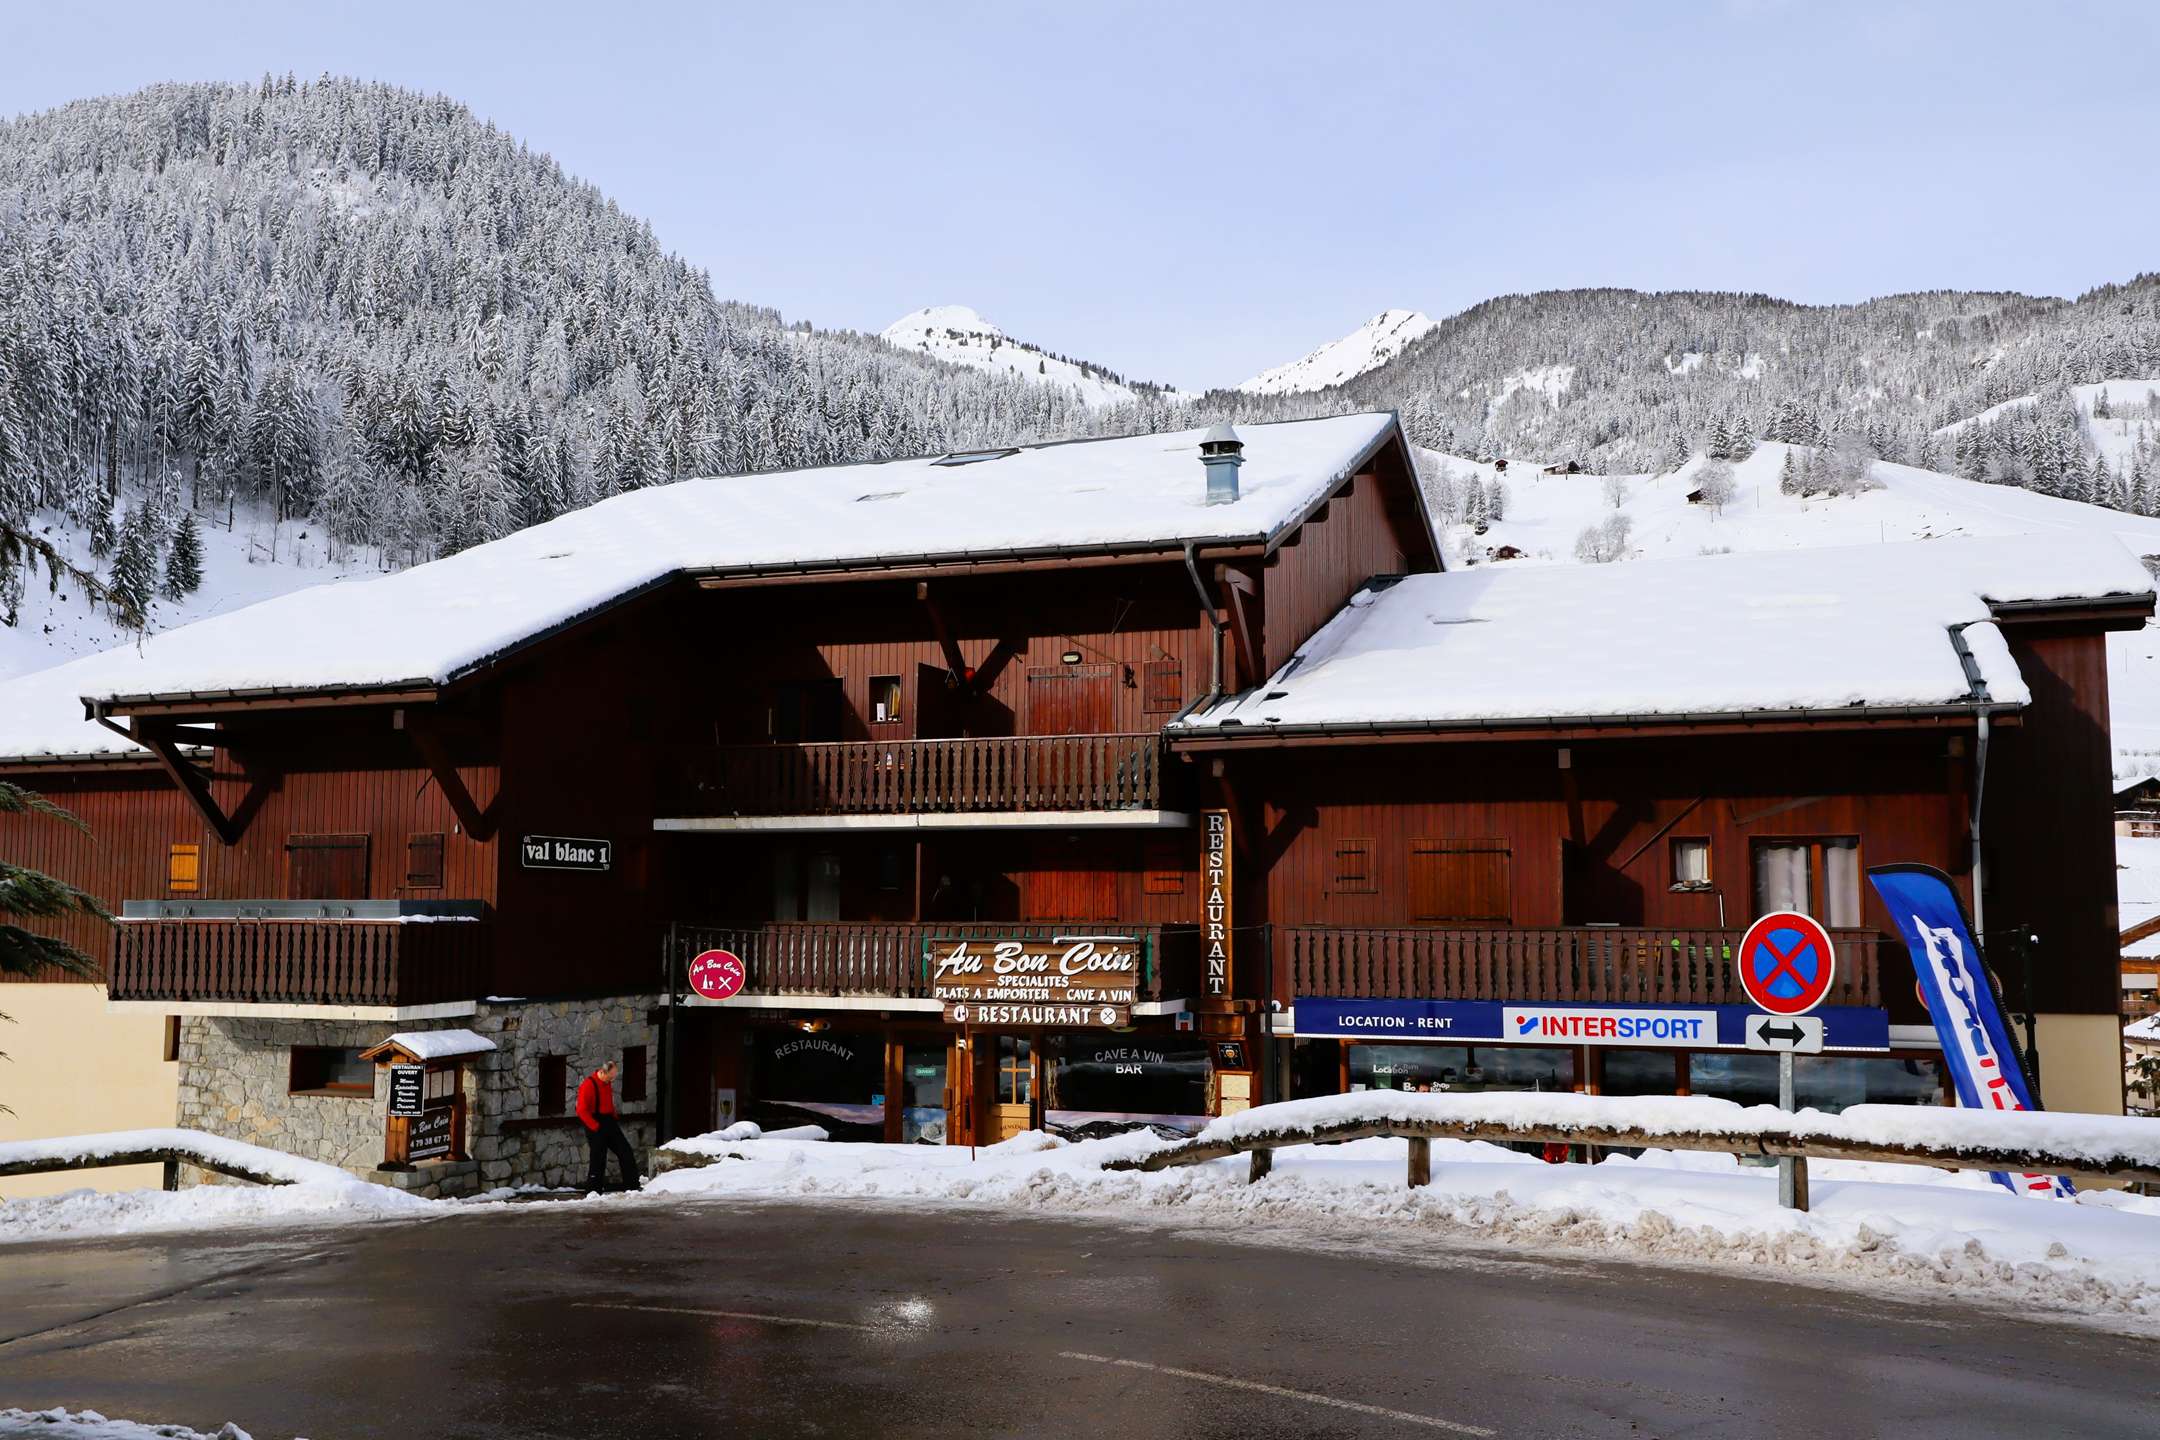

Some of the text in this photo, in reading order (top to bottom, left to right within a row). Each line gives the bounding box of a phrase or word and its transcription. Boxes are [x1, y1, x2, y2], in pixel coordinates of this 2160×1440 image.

[526, 841, 608, 863] val blanc 1
[1208, 815, 1226, 994] RESTAURANT
[693, 959, 741, 977] Au Bon Coin
[934, 942, 1133, 979] Au Bon Coin
[997, 975, 1069, 988] SPECIALITES
[935, 987, 969, 999] PLATS
[974, 989, 982, 999] A
[986, 989, 1050, 1000] EMPORTER
[1066, 989, 1095, 1001] CAVE
[1099, 989, 1107, 1001] A
[1111, 990, 1132, 1001] VIN
[978, 1006, 1092, 1024] RESTAURANT
[1338, 1016, 1405, 1028] LOCATION
[1417, 1017, 1453, 1028] RENT
[1542, 1015, 1703, 1039] INTERSPORT
[775, 1039, 854, 1061] RESTAURANT
[1094, 1048, 1165, 1065] CAVE A VIN
[1115, 1063, 1143, 1075] BAR
[1373, 1063, 1409, 1074] Location
